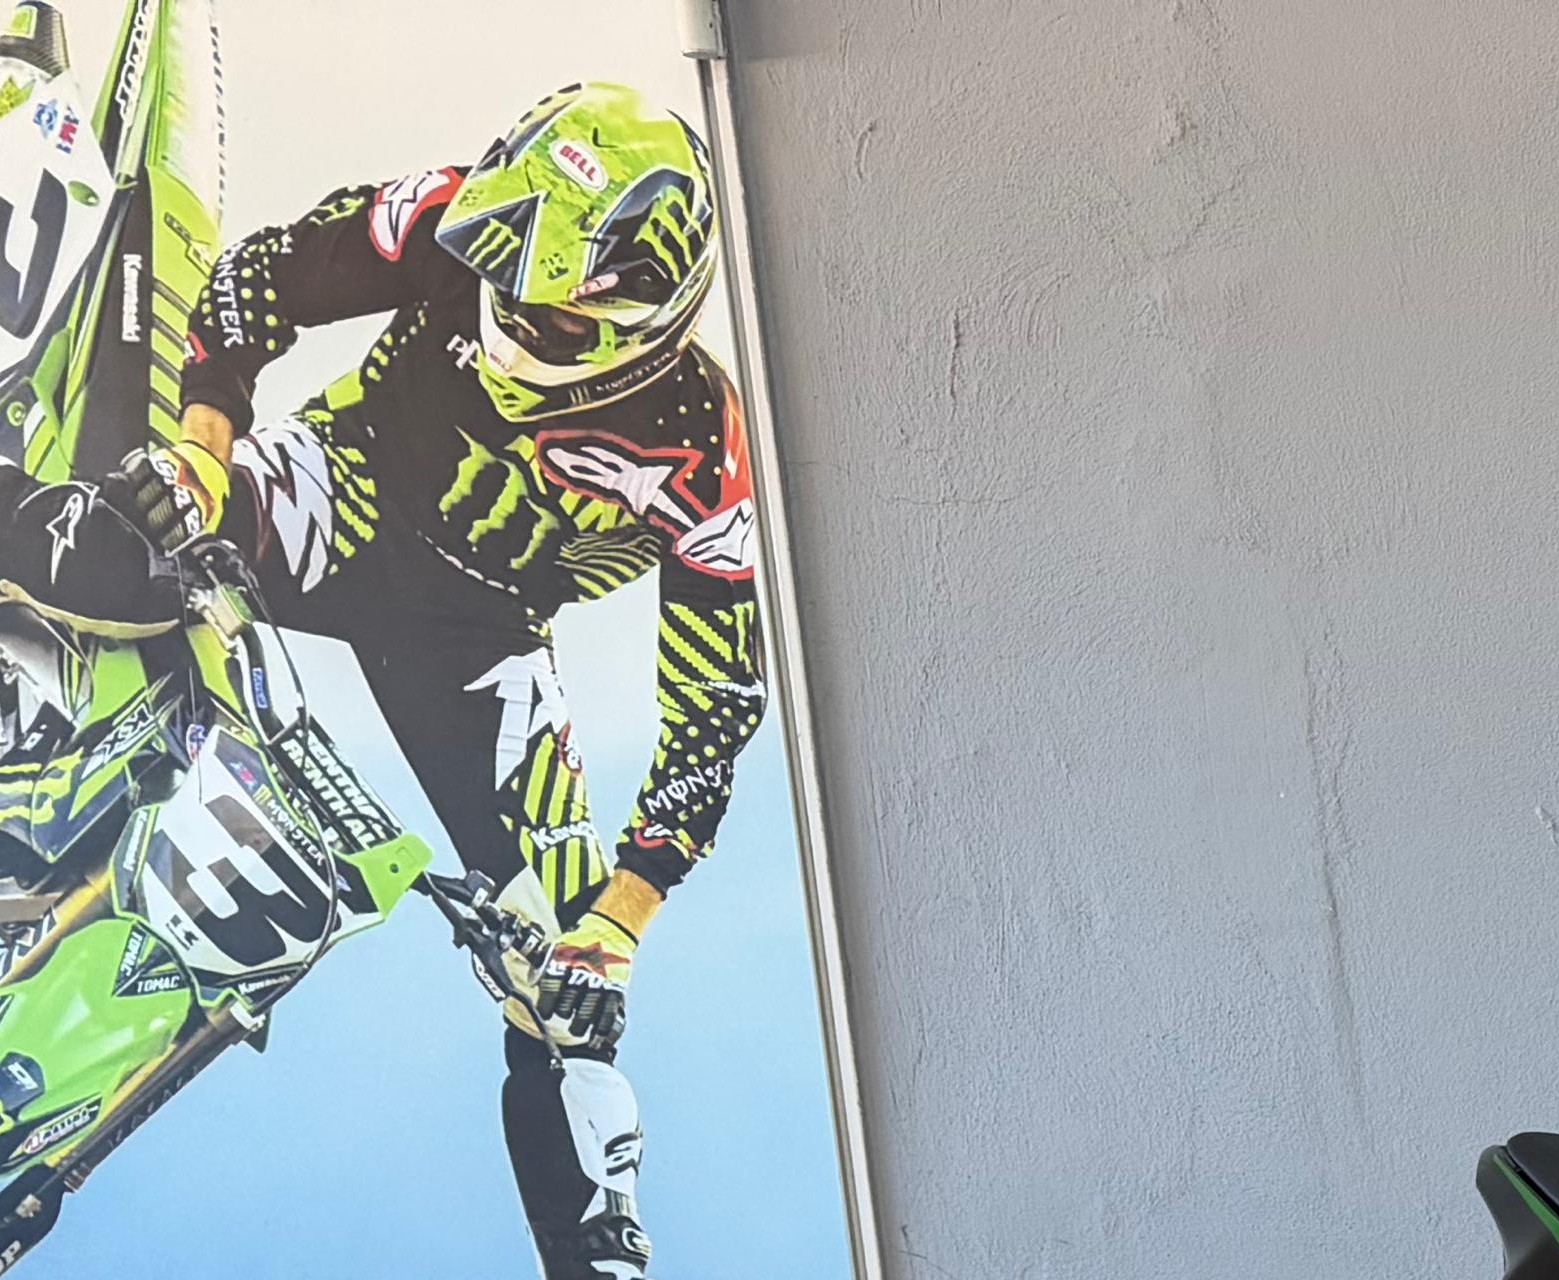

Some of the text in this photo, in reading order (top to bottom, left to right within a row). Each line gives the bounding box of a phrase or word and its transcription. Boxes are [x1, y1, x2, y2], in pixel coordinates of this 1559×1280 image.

[558, 144, 597, 183] BELL
[122, 253, 142, 342] Kawasaki
[136, 975, 180, 994] TOMAC
